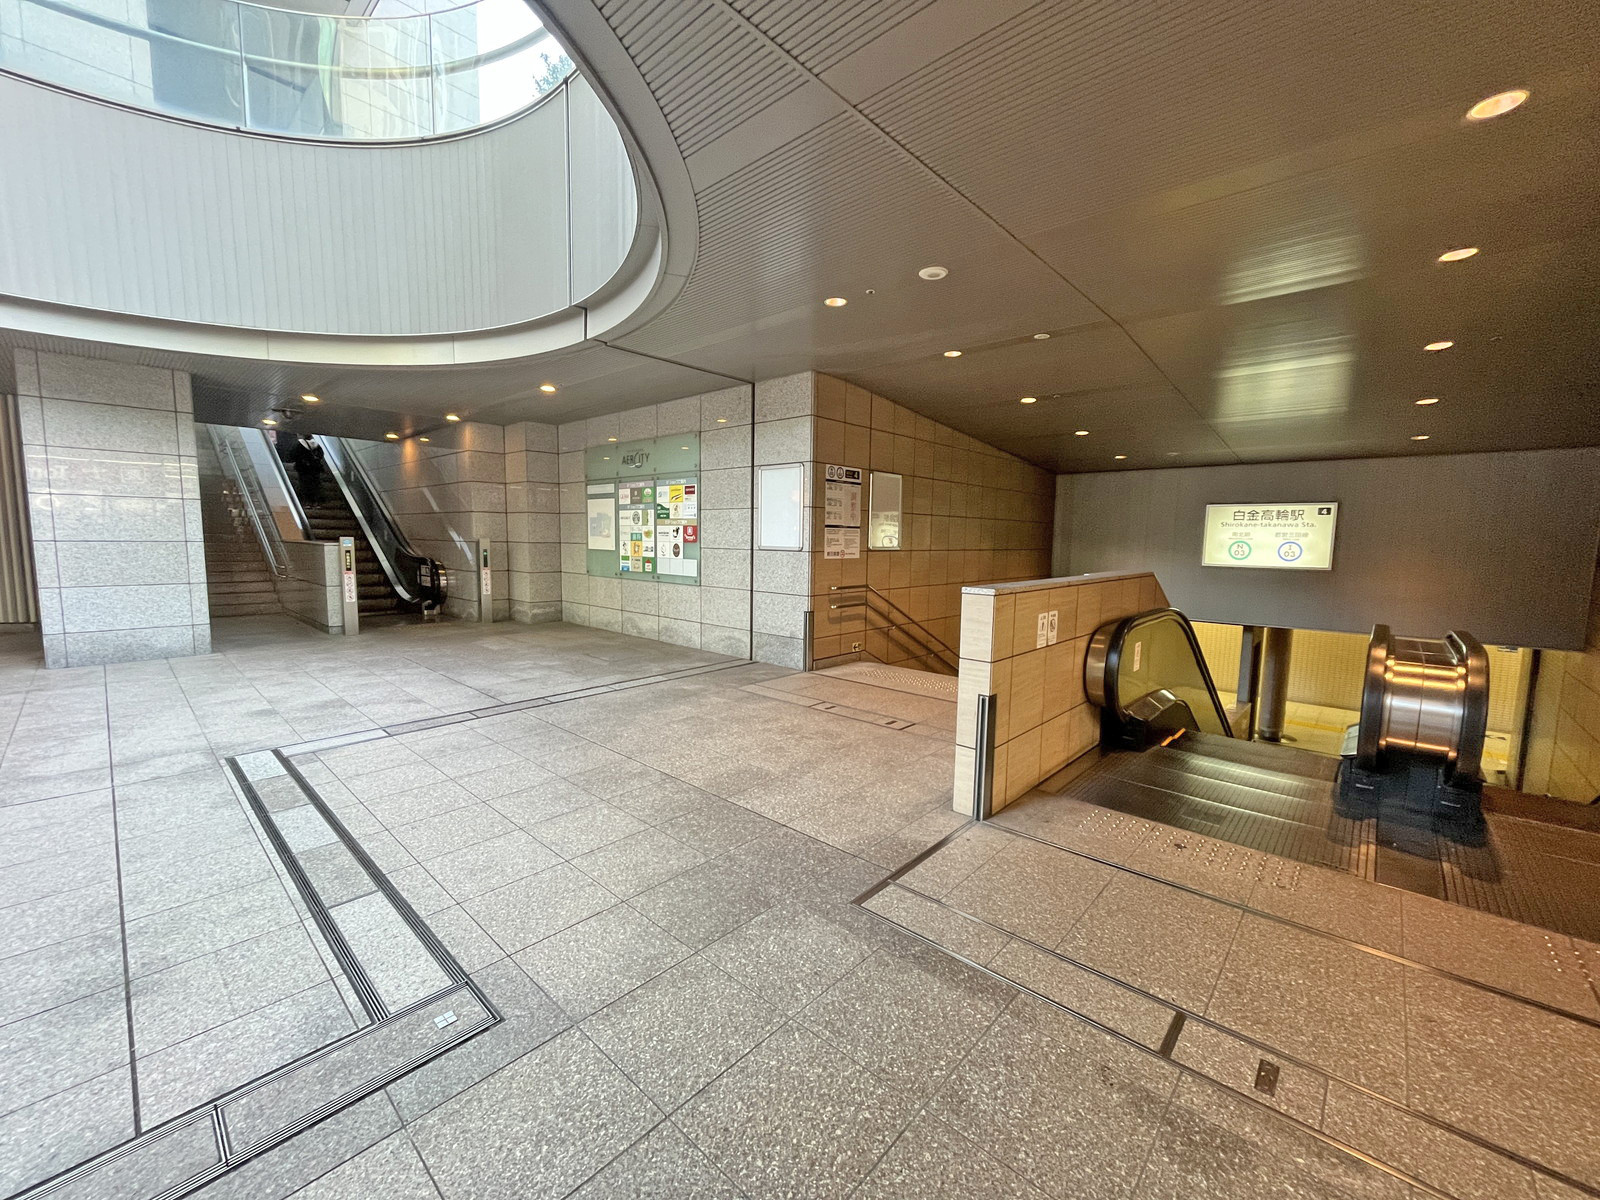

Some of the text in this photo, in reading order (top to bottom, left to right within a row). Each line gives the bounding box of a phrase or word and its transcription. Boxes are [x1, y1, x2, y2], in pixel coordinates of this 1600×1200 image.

[1233, 509, 1305, 521] 白金高輪駅
